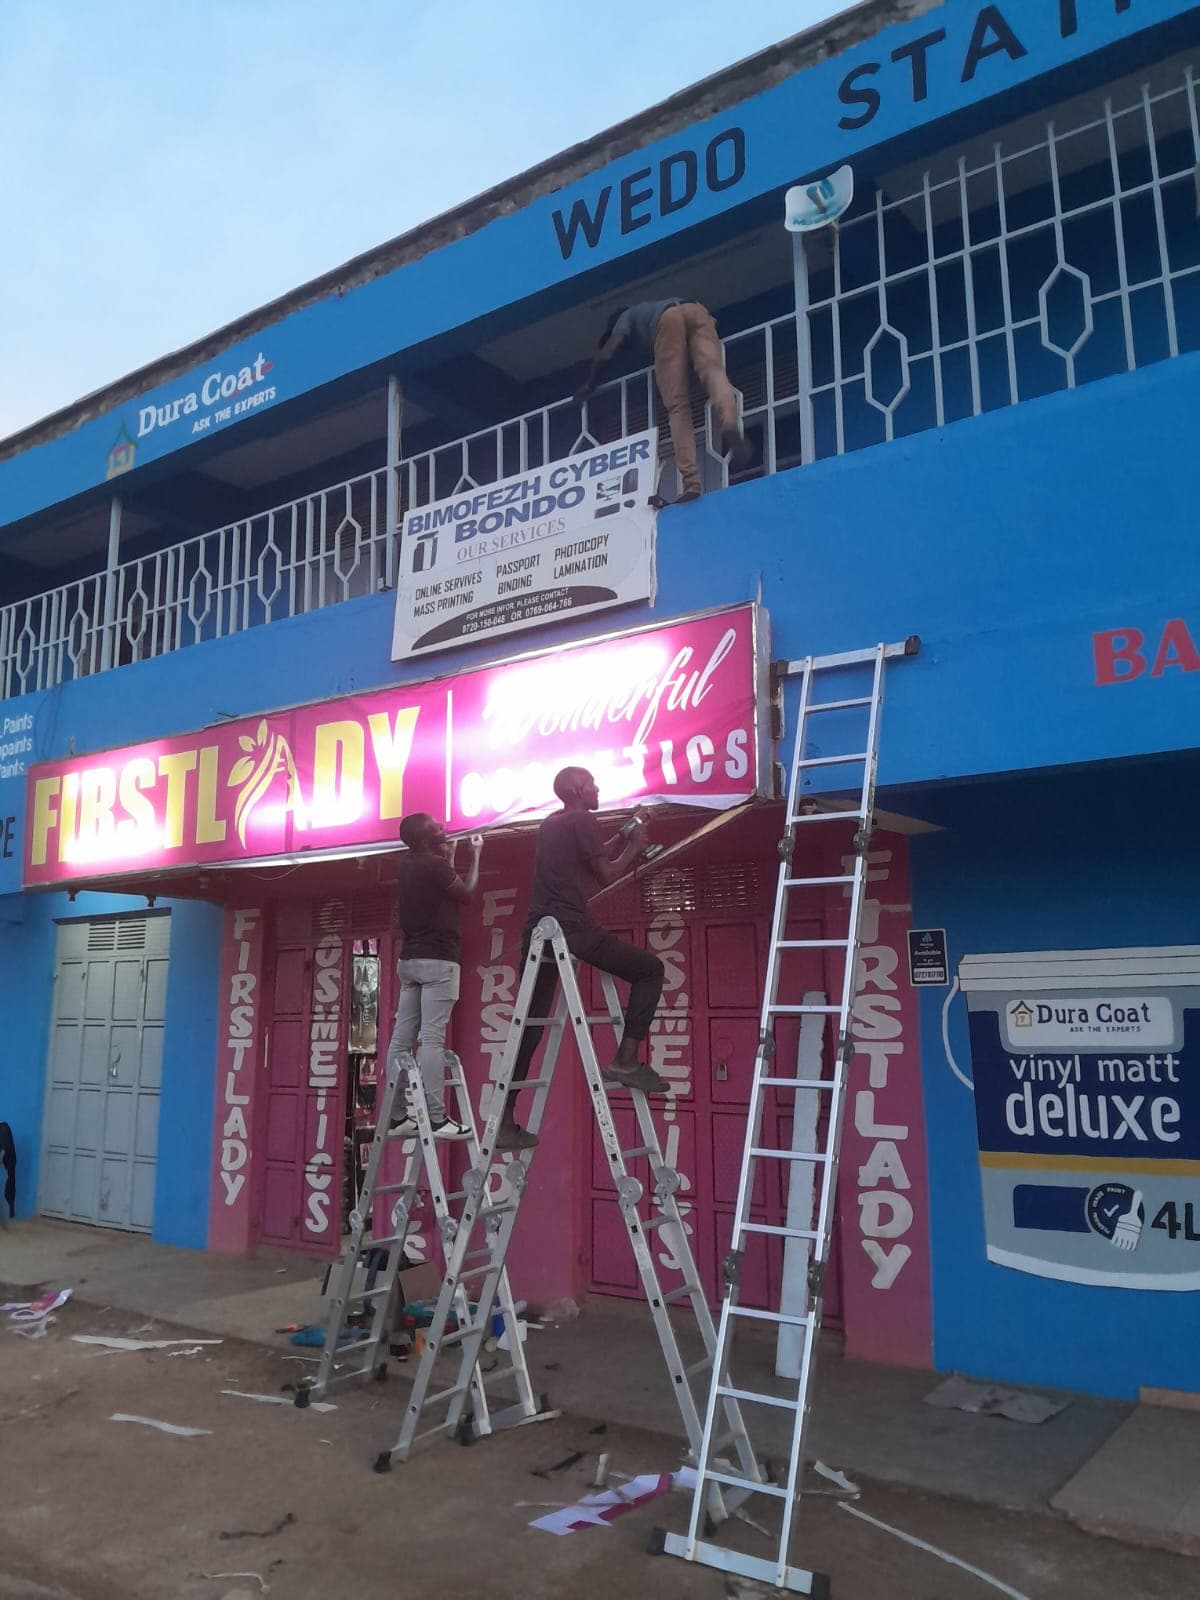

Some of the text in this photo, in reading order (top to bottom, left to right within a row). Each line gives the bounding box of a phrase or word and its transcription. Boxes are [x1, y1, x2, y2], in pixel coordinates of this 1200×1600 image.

[552, 127, 746, 260] WEDO
[137, 352, 266, 438] Dura Coat
[192, 387, 276, 434] ASK THE EXPERTS
[408, 439, 650, 536] BIMOFEZH CYBER
[455, 486, 585, 543] BONDO
[456, 517, 566, 561] OUR SERVICES
[554, 534, 609, 561] PHOTOCOPY
[496, 554, 541, 578] PASSPORT
[553, 553, 608, 580] LAMINATION
[415, 571, 482, 600] ONLINE SERVIVES
[498, 575, 532, 595] BINDING
[516, 595, 539, 608] PLEASE
[540, 588, 568, 602] CONTACT
[413, 591, 474, 618] MASS PRINTING
[511, 610, 522, 621] OR
[0, 736, 32, 761] paints
[0, 759, 24, 778] aints
[1036, 1002, 1152, 1024] Dura Coat
[220, 908, 261, 1206] FIRSTLADY
[305, 898, 345, 1233] COSMETICS
[841, 851, 914, 1290] FIRSTLADY
[1009, 1053, 1180, 1089] vinyl matt
[1005, 1081, 1181, 1143] deluxe
